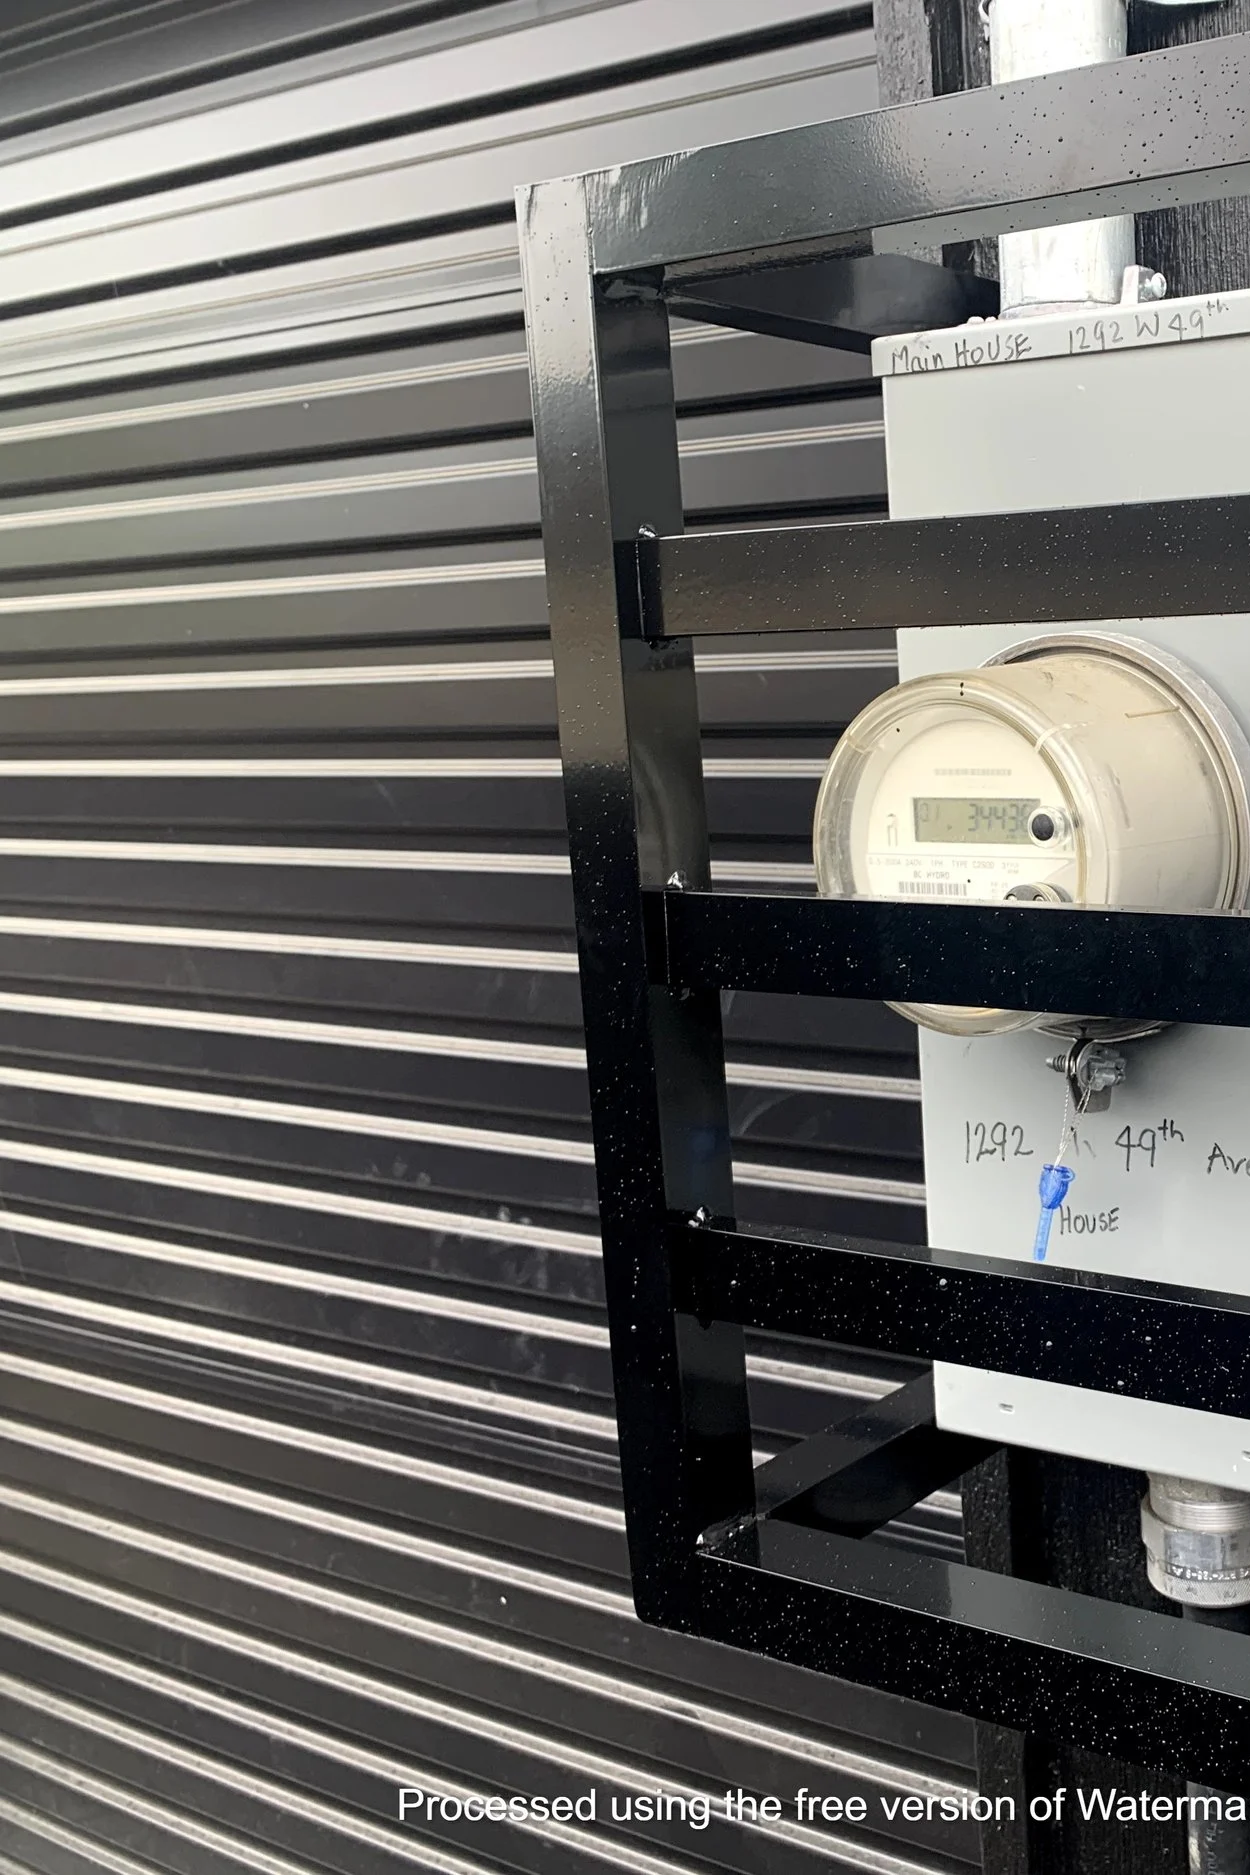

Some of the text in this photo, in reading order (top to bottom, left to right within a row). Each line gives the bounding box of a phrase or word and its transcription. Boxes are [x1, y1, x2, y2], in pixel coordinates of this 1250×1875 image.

[892, 344, 945, 374] Main
[954, 333, 1033, 368] HOUSE
[1068, 320, 1124, 354] 1292
[1134, 311, 1160, 338] W
[965, 1120, 1034, 1164] 1292
[1115, 1118, 1185, 1172] 49th
[1059, 1206, 1120, 1236] HOUSE
